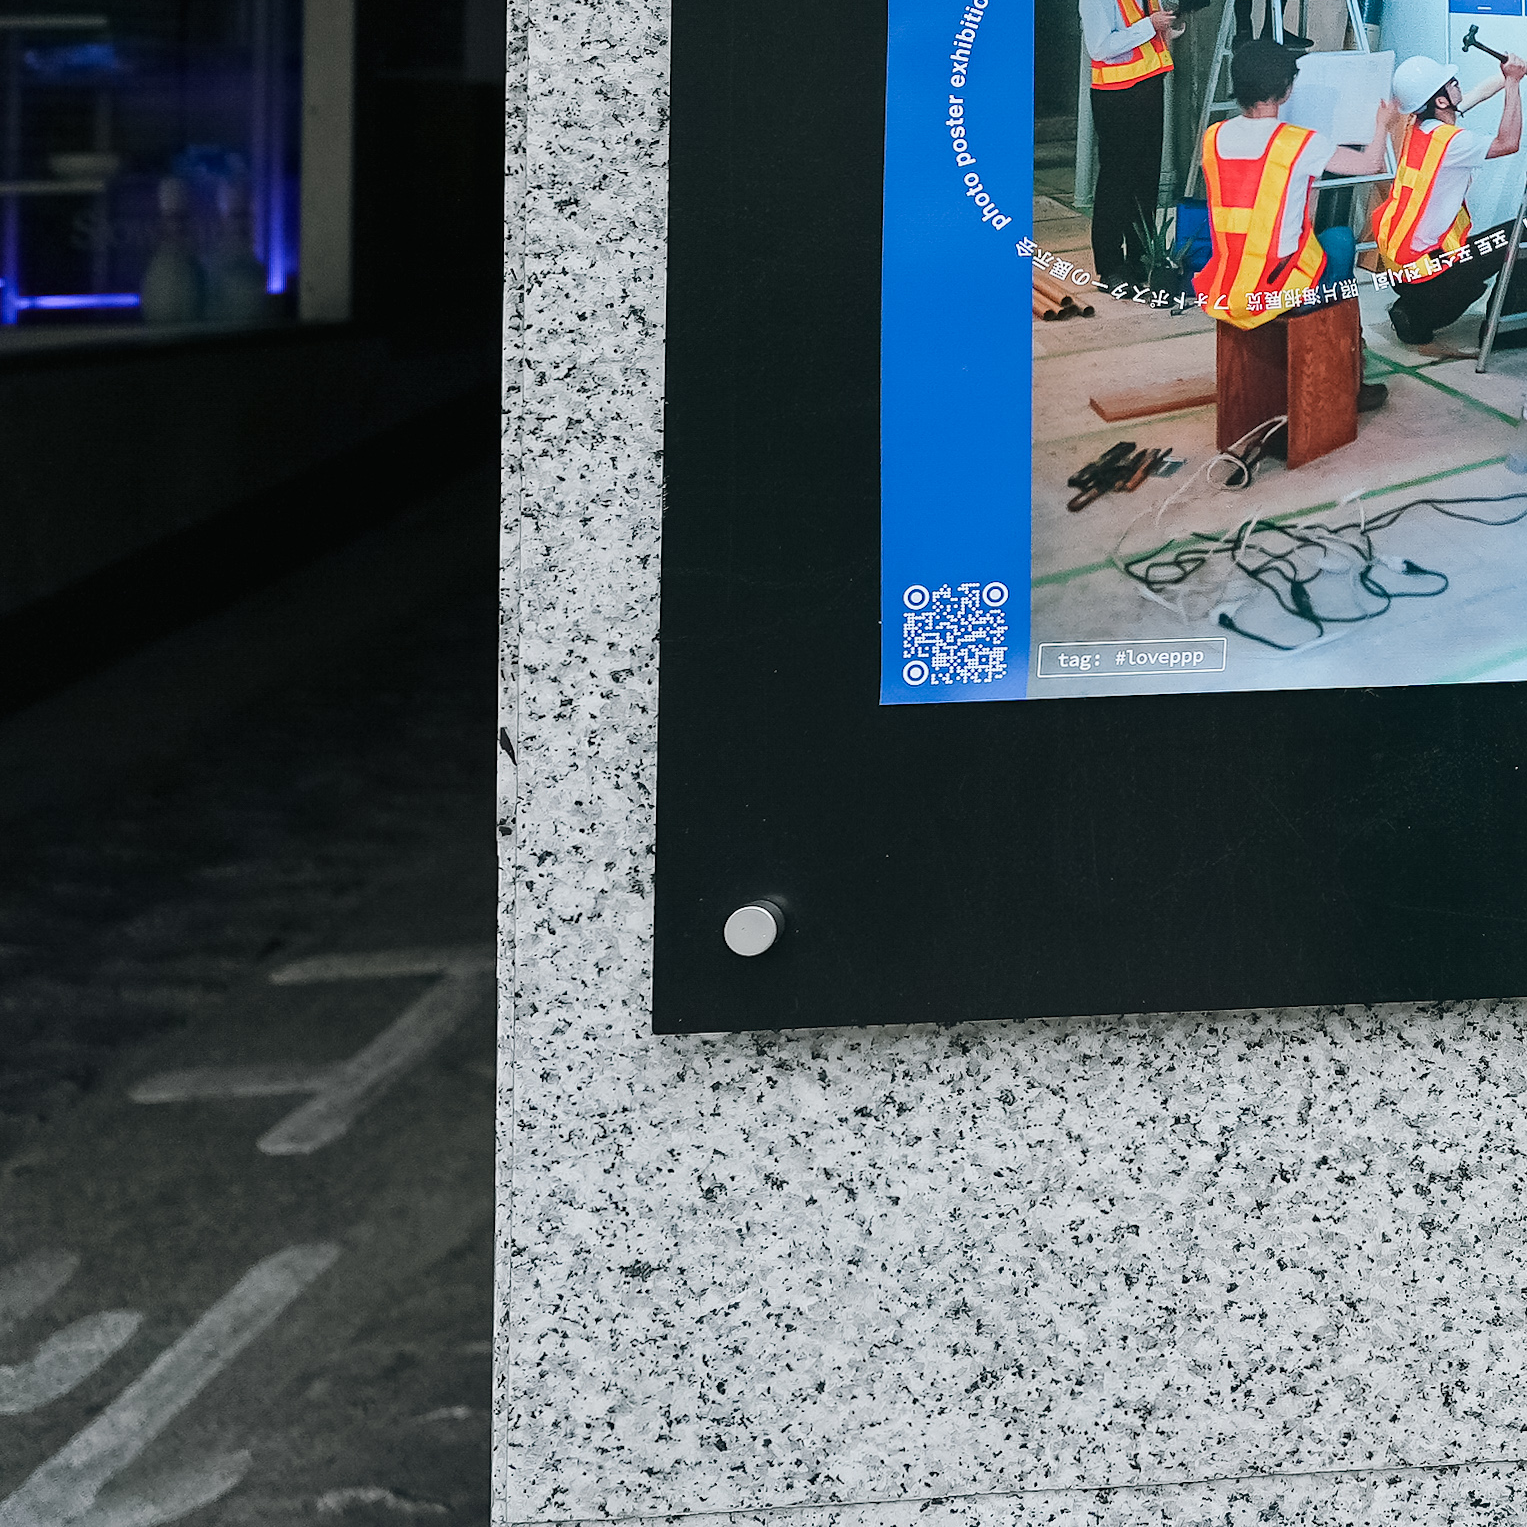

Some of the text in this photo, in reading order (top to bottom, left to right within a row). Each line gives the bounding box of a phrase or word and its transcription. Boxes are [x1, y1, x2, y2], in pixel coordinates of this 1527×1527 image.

[945, 94, 977, 168] poster
[963, 171, 1013, 232] photo
[1015, 236, 1230, 311] フォトポスターの展示会
[1371, 229, 1510, 292] 포토 포스터 전시회
[1245, 277, 1359, 311] 照片海报展览
[1057, 649, 1205, 669] tag: #loveppp
